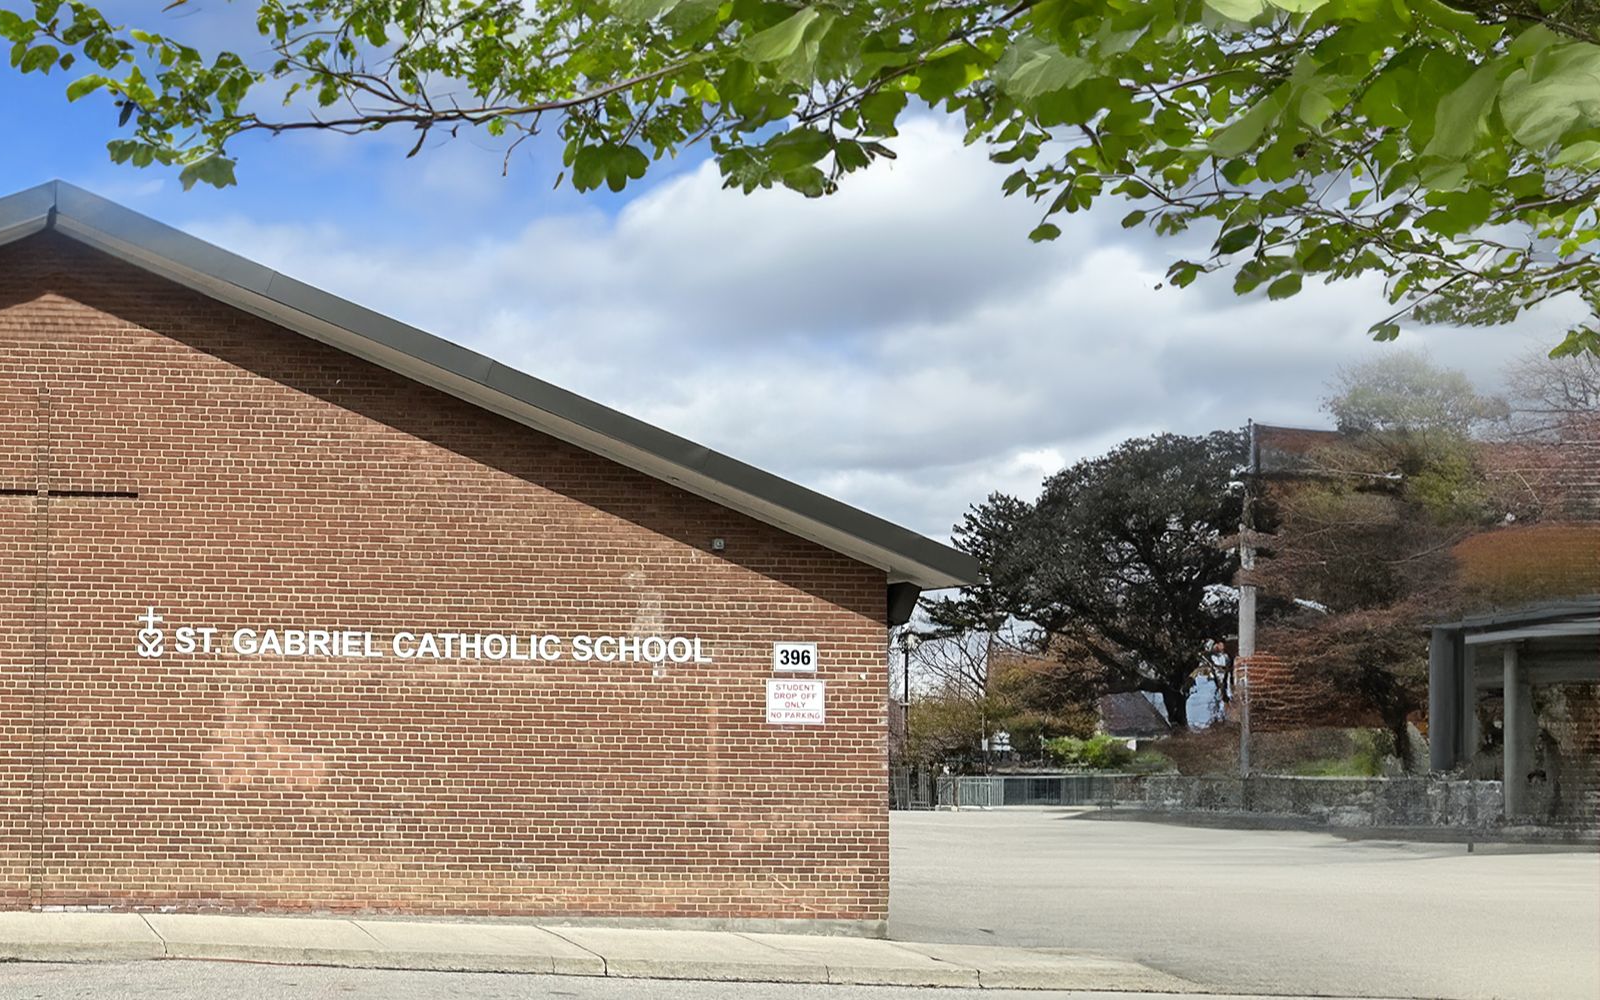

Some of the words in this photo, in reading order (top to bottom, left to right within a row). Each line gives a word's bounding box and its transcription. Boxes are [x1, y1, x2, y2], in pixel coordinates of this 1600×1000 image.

[174, 627, 221, 654] ST.
[232, 628, 385, 658] GABRIEL
[392, 631, 562, 662] CATHOLIC
[571, 634, 714, 663] SCHOOL
[780, 649, 811, 666] 396
[773, 692, 798, 700] DROP
[770, 711, 782, 719] NO
